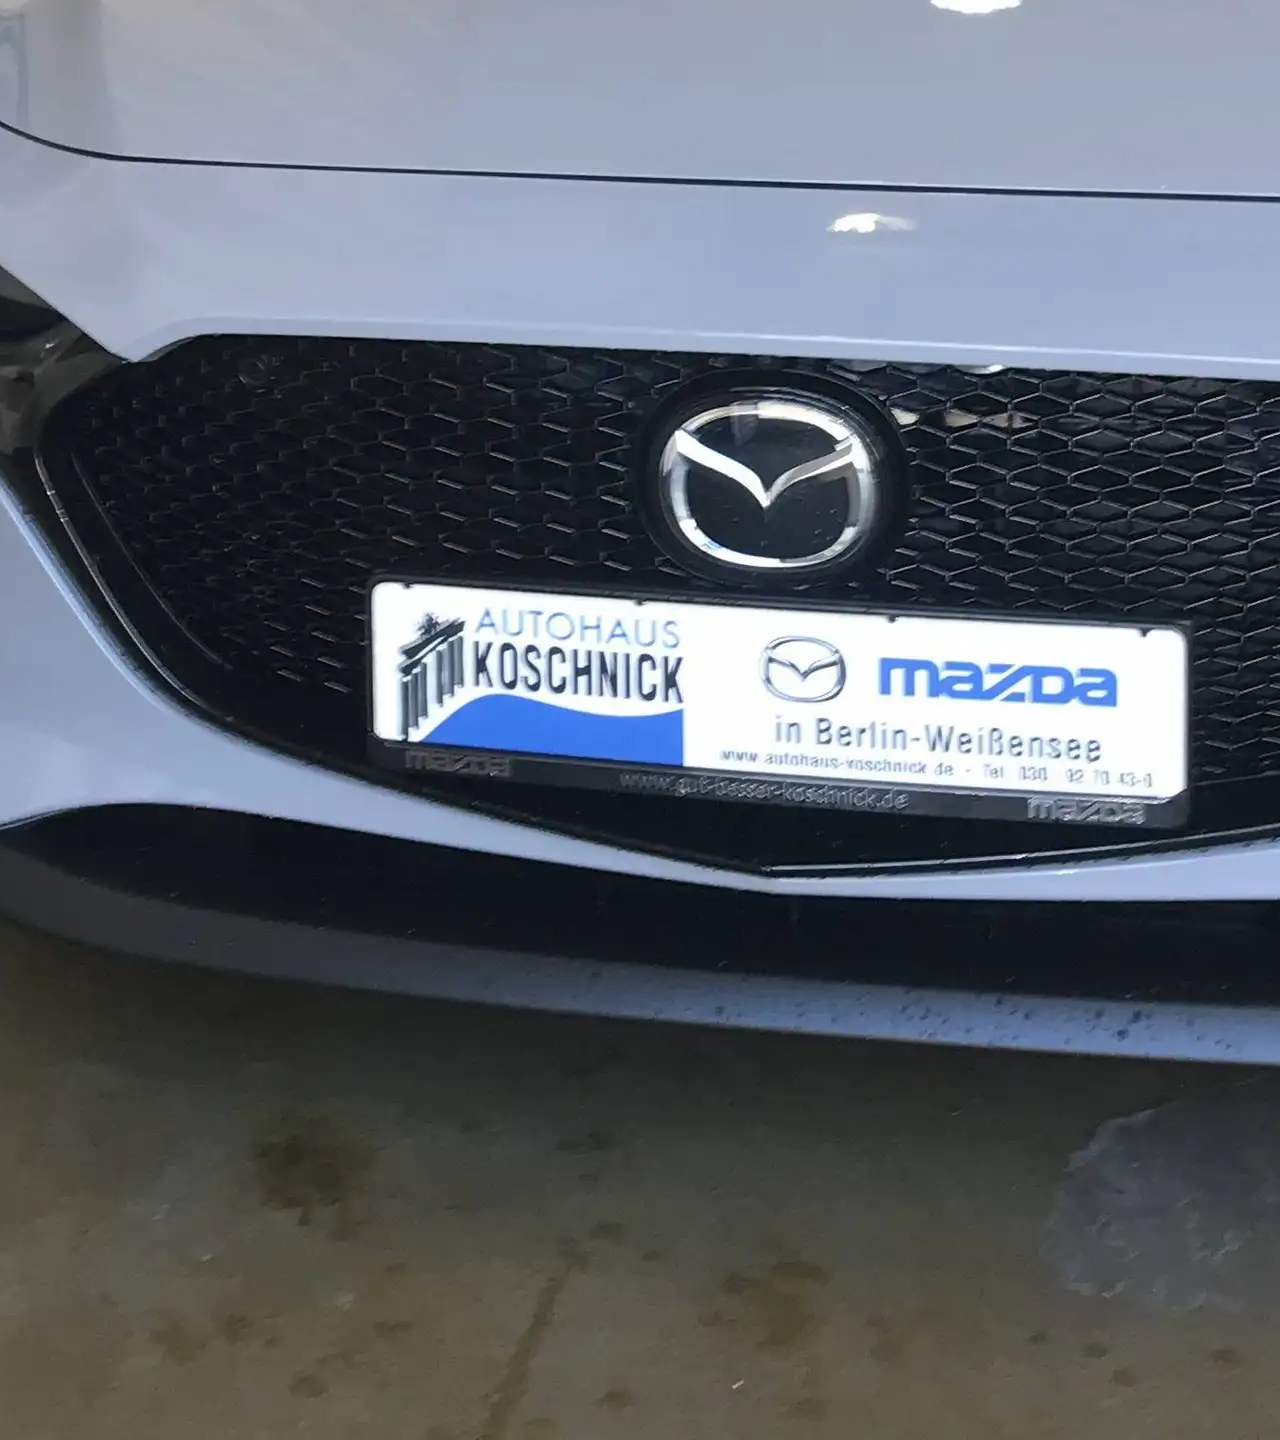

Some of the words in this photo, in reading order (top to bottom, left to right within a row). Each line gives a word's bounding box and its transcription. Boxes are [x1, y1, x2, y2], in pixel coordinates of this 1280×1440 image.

[474, 607, 681, 650] AUTOHAUS
[472, 640, 684, 704] KOSCHNICK
[878, 657, 1118, 708] mazda
[774, 715, 802, 745] in
[815, 716, 1103, 764] Berlin-Weißensee
[1026, 794, 1148, 825] mazda
